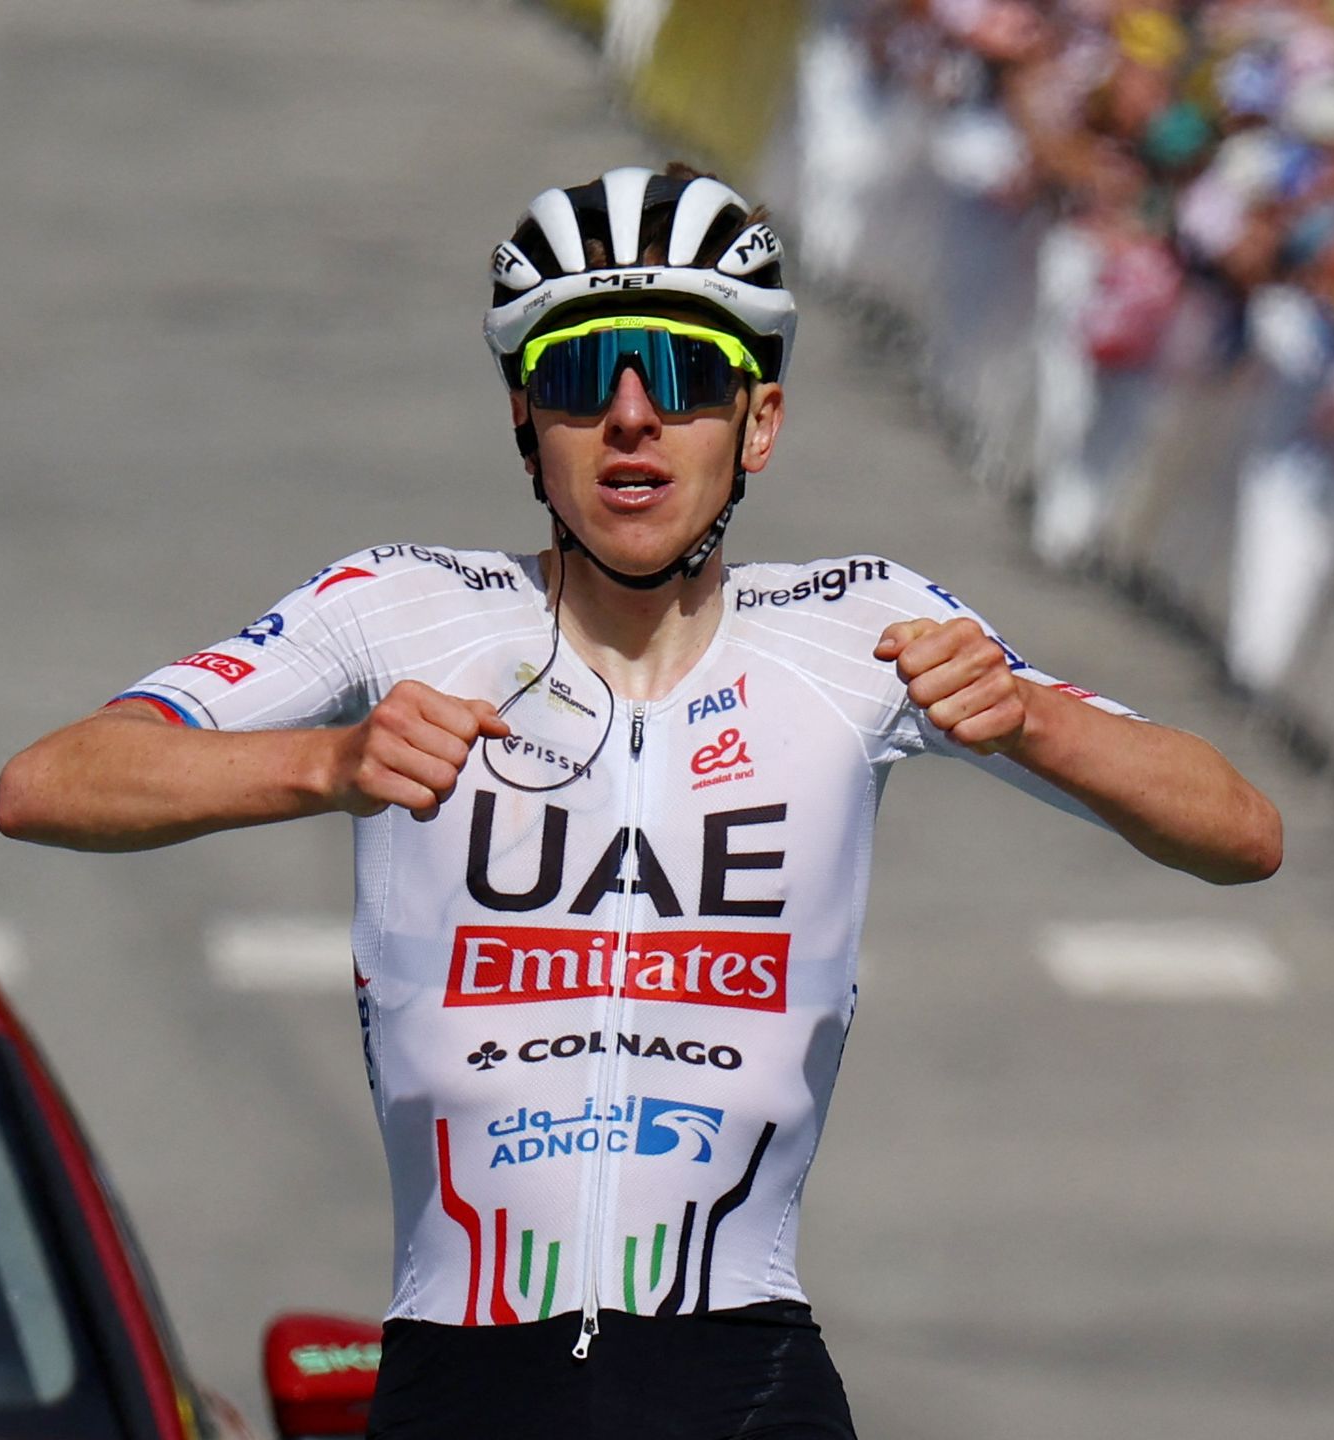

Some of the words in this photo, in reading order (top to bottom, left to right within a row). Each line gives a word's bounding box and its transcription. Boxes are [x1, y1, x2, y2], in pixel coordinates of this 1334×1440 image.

[589, 272, 662, 290] MET
[371, 542, 519, 592] presight
[735, 558, 891, 612] presight
[550, 677, 572, 696] UCI
[523, 742, 592, 780] PISSEI
[734, 768, 755, 781] and
[467, 789, 787, 917] UAE
[460, 936, 778, 1000] Emirates
[518, 1030, 744, 1071] COLNAGO
[489, 1127, 629, 1169] ADNOC
